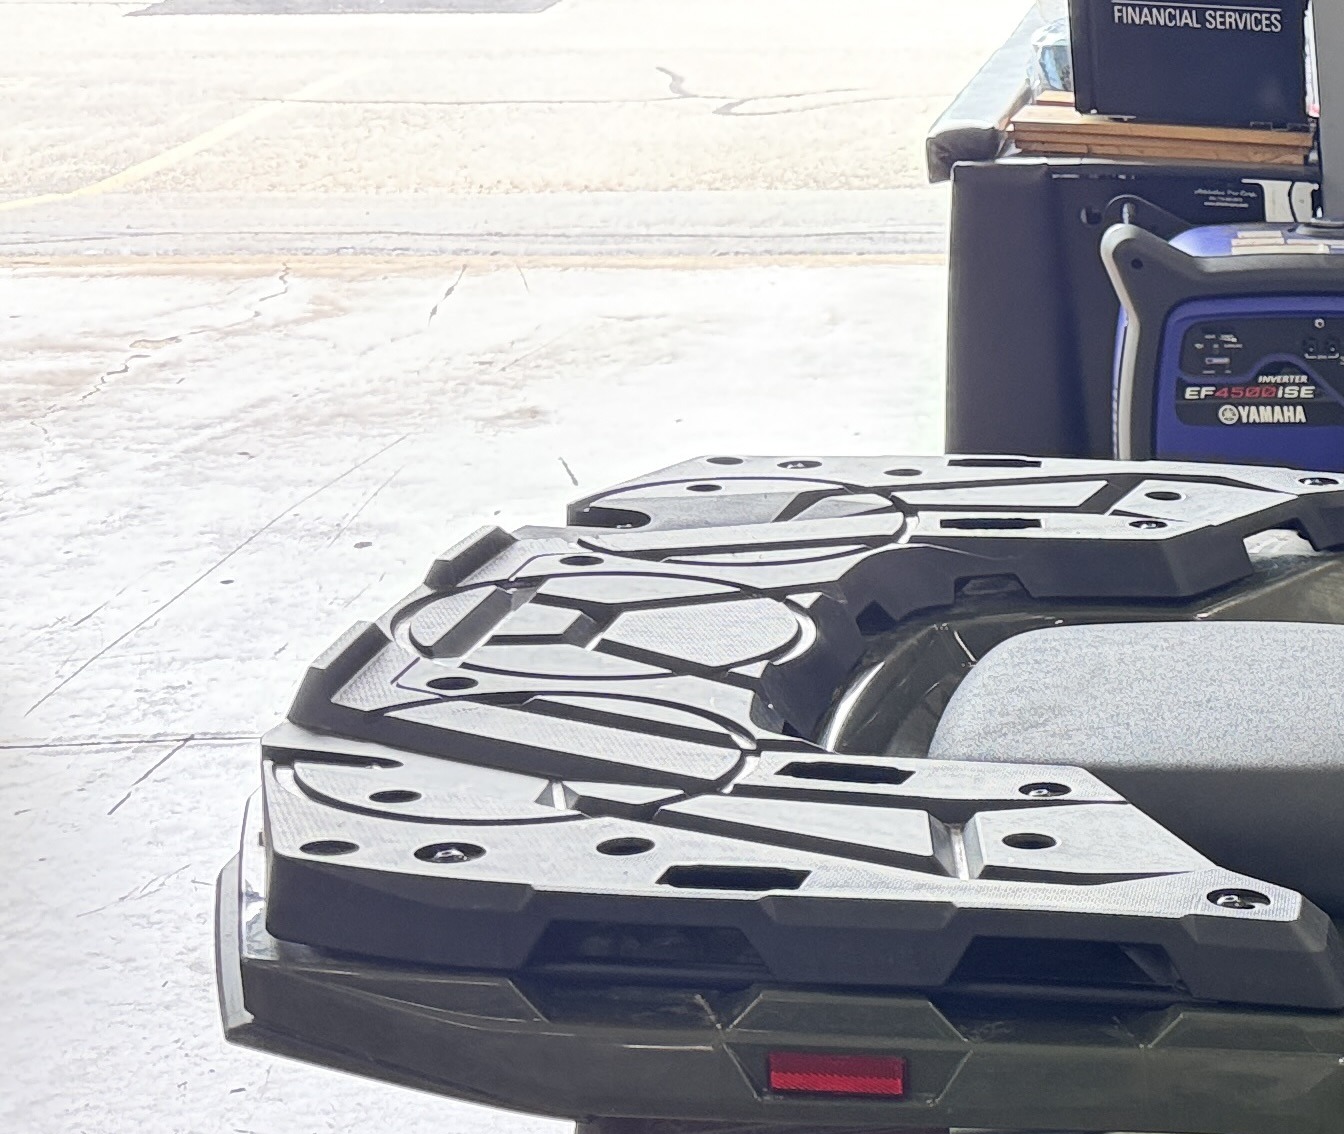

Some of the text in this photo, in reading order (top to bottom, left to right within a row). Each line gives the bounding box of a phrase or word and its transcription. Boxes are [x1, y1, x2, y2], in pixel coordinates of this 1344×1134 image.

[1113, 5, 1282, 32] FINANCIAL SERVICES
[1258, 374, 1309, 384] INVERTER
[1238, 405, 1307, 423] YAMAHA
